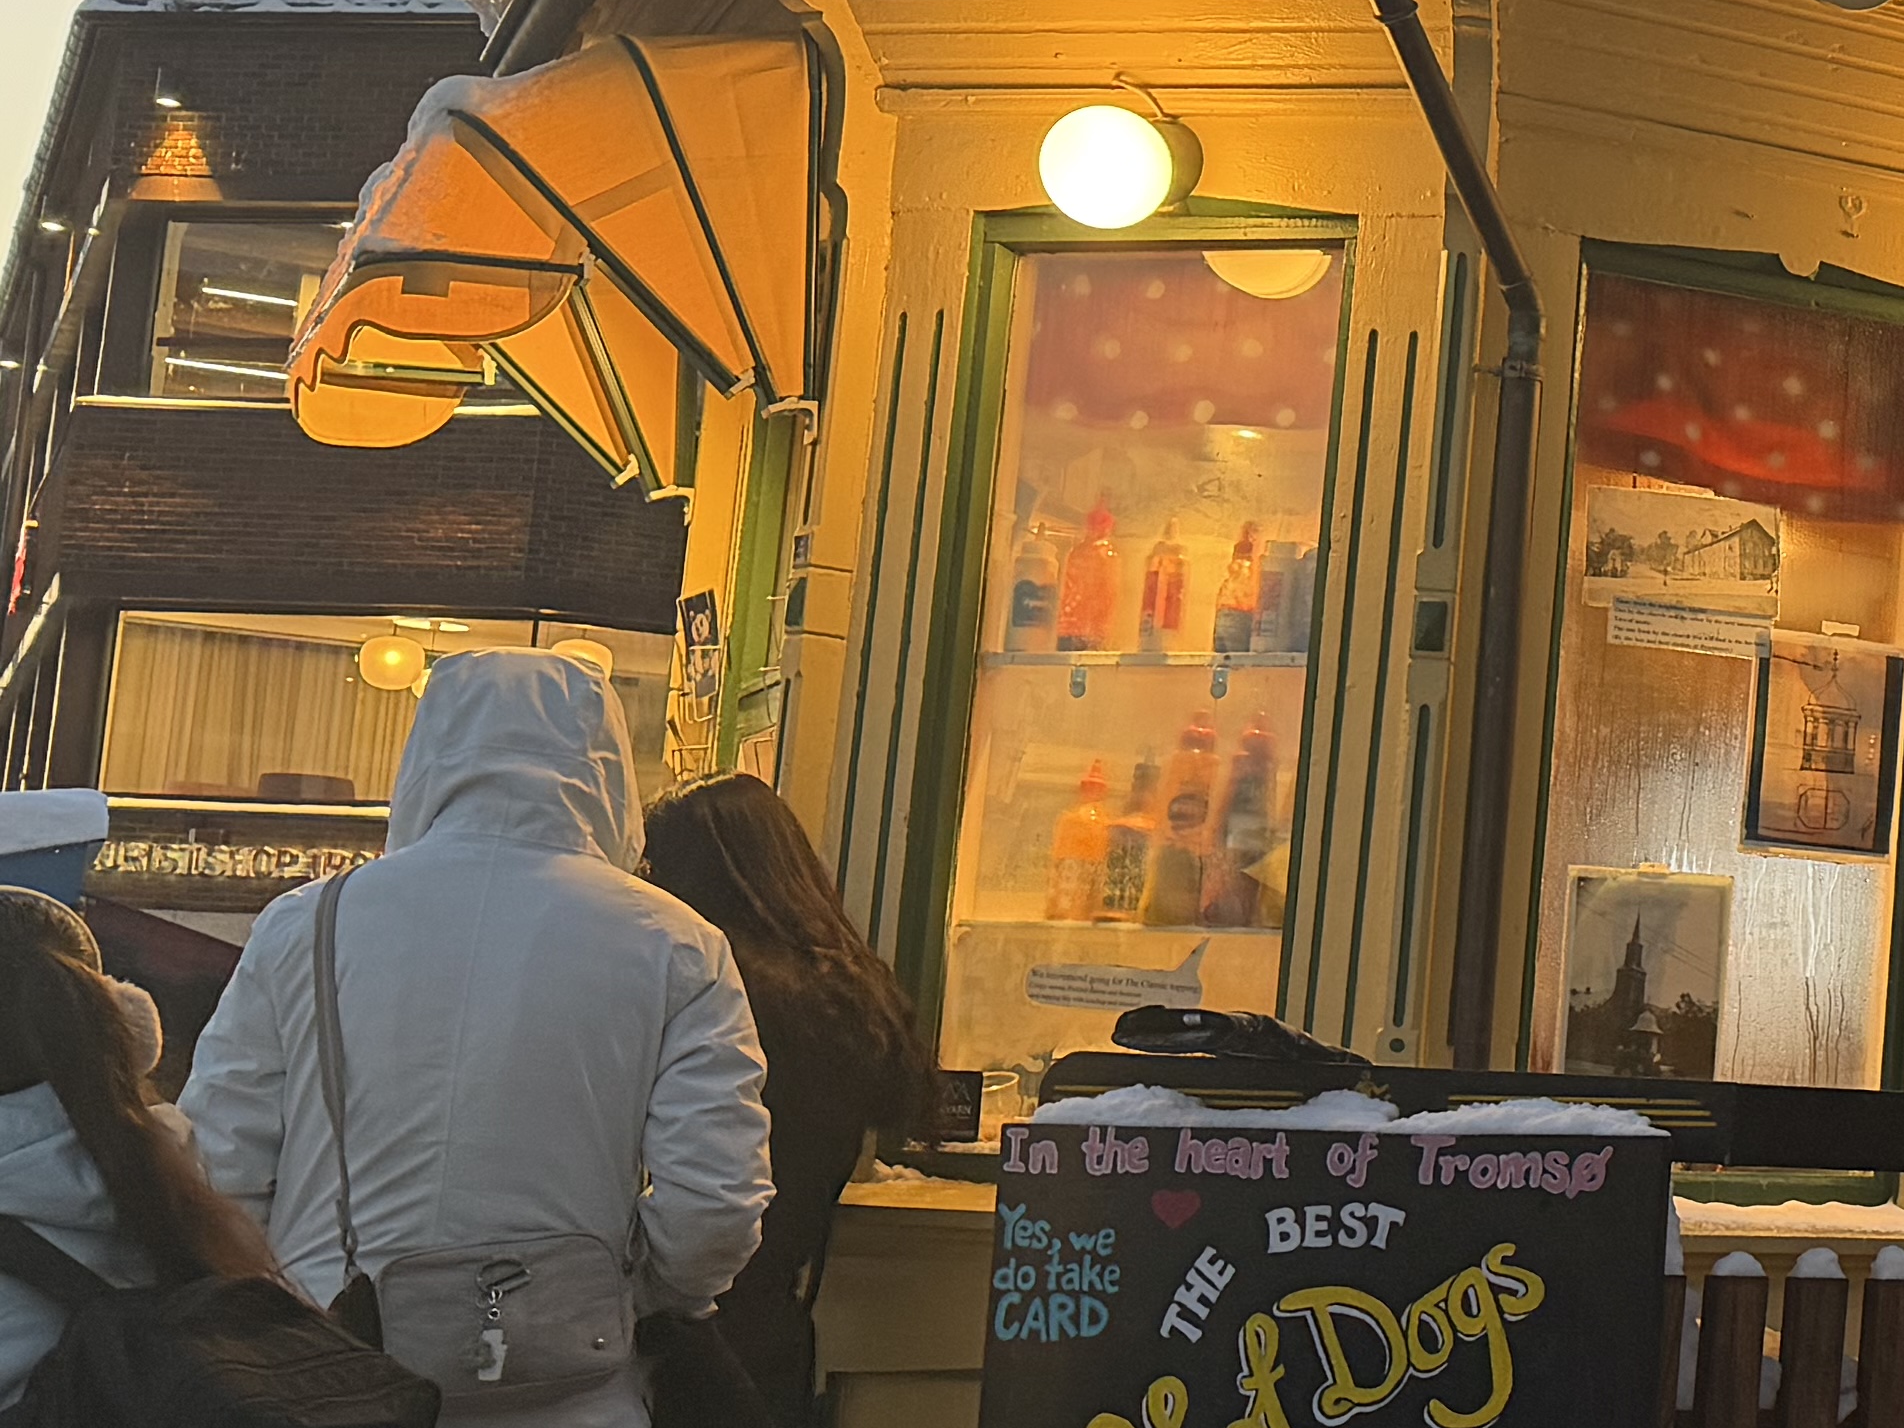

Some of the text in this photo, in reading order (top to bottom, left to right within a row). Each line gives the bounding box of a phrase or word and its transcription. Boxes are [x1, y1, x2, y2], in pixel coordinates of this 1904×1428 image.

[1002, 1127, 1614, 1199] In the heart of Tromsø
[998, 1202, 1116, 1259] Yes, we
[1265, 1201, 1408, 1255] BEST
[993, 1253, 1121, 1294] do take
[1160, 1245, 1236, 1345] THE
[994, 1291, 1110, 1343] CARD
